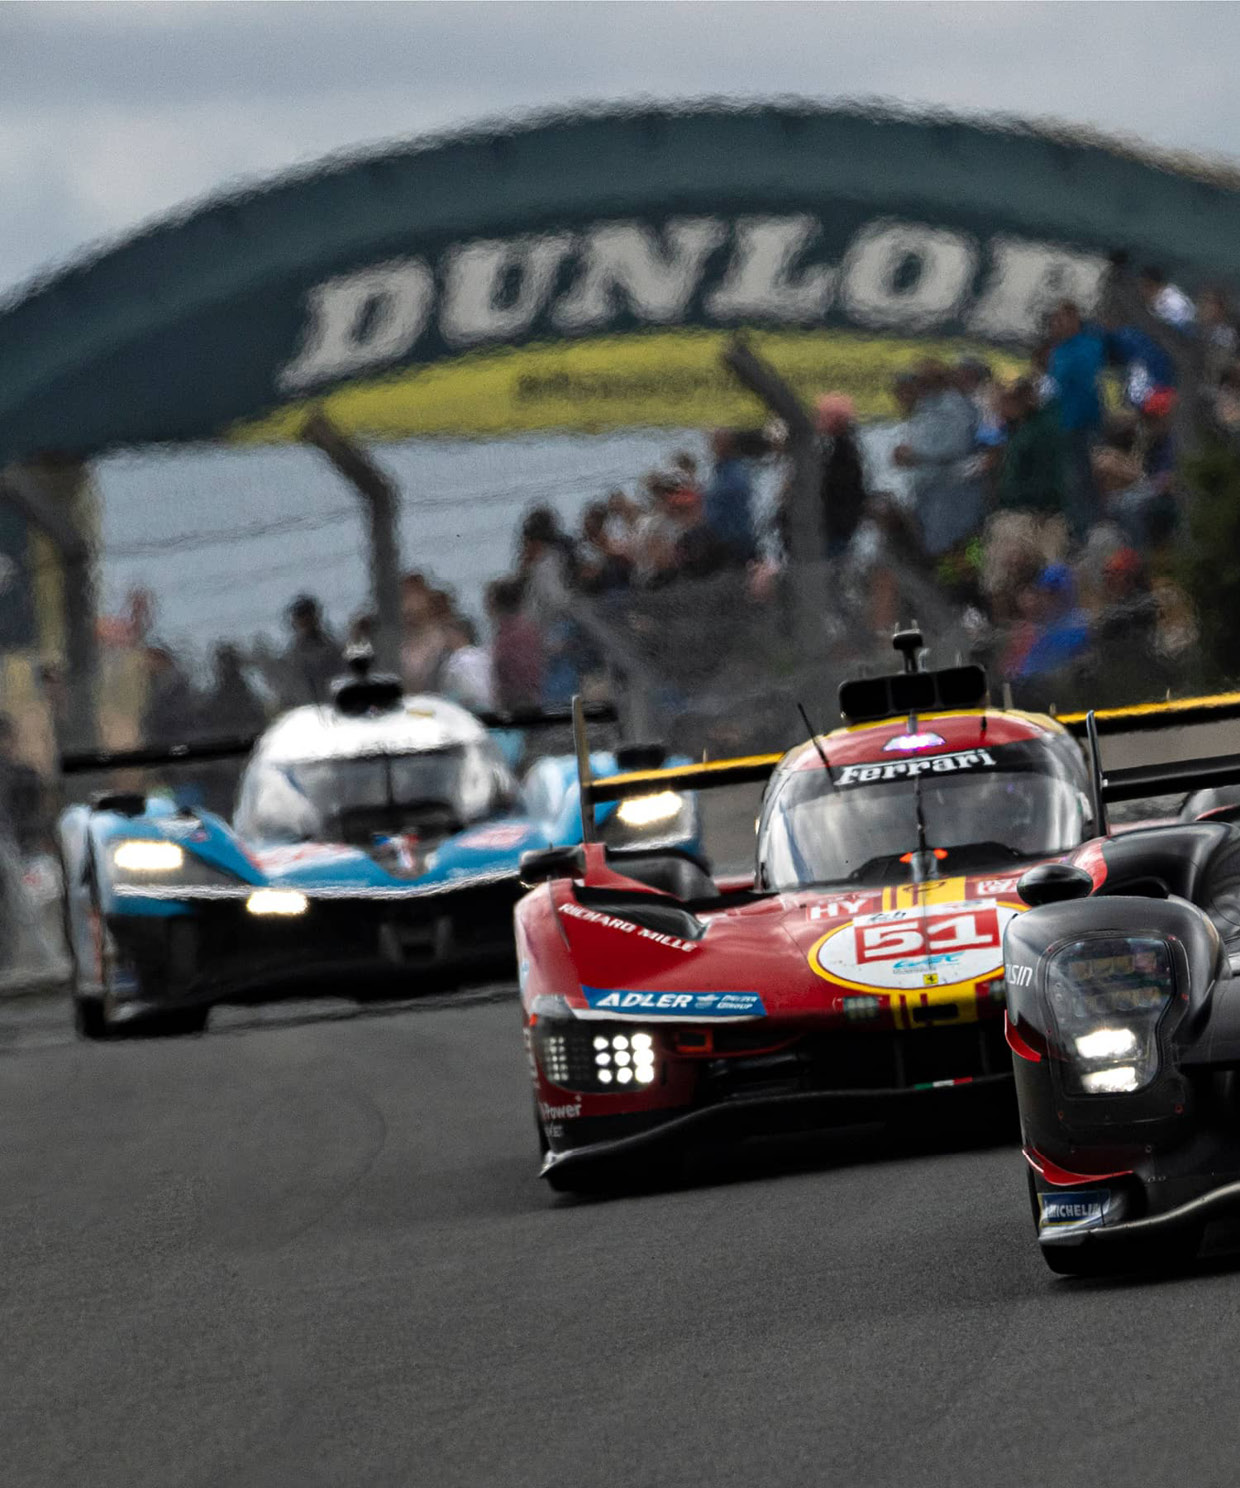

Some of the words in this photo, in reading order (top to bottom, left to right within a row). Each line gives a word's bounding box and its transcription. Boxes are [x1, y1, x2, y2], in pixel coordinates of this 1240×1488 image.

[833, 749, 998, 786] Ferrari
[811, 898, 868, 920] HY
[558, 903, 637, 934] RICHARD
[637, 926, 698, 952] MILLE
[863, 914, 994, 958] 51
[596, 992, 693, 1009] ADLER
[1046, 1203, 1101, 1218] MICHELIN
